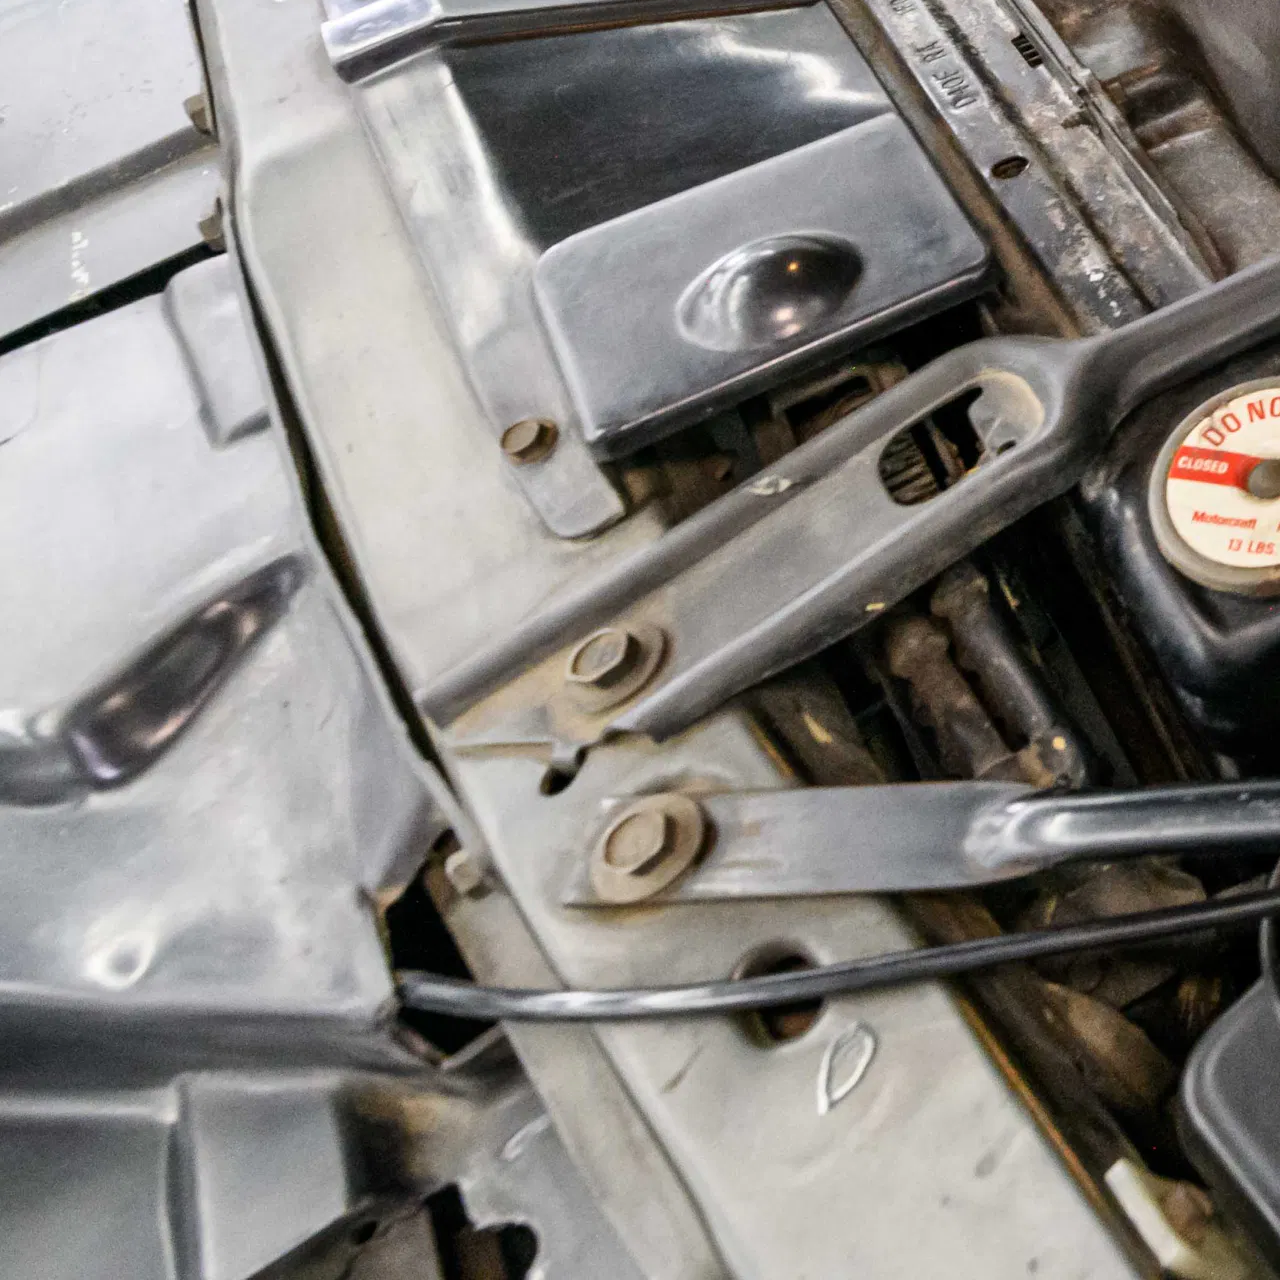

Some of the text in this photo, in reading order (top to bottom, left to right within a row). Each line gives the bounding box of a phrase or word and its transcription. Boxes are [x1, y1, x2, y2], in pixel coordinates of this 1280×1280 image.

[1201, 412, 1242, 448] DO
[1176, 455, 1230, 475] CLOSED
[1227, 538, 1245, 552] 13
